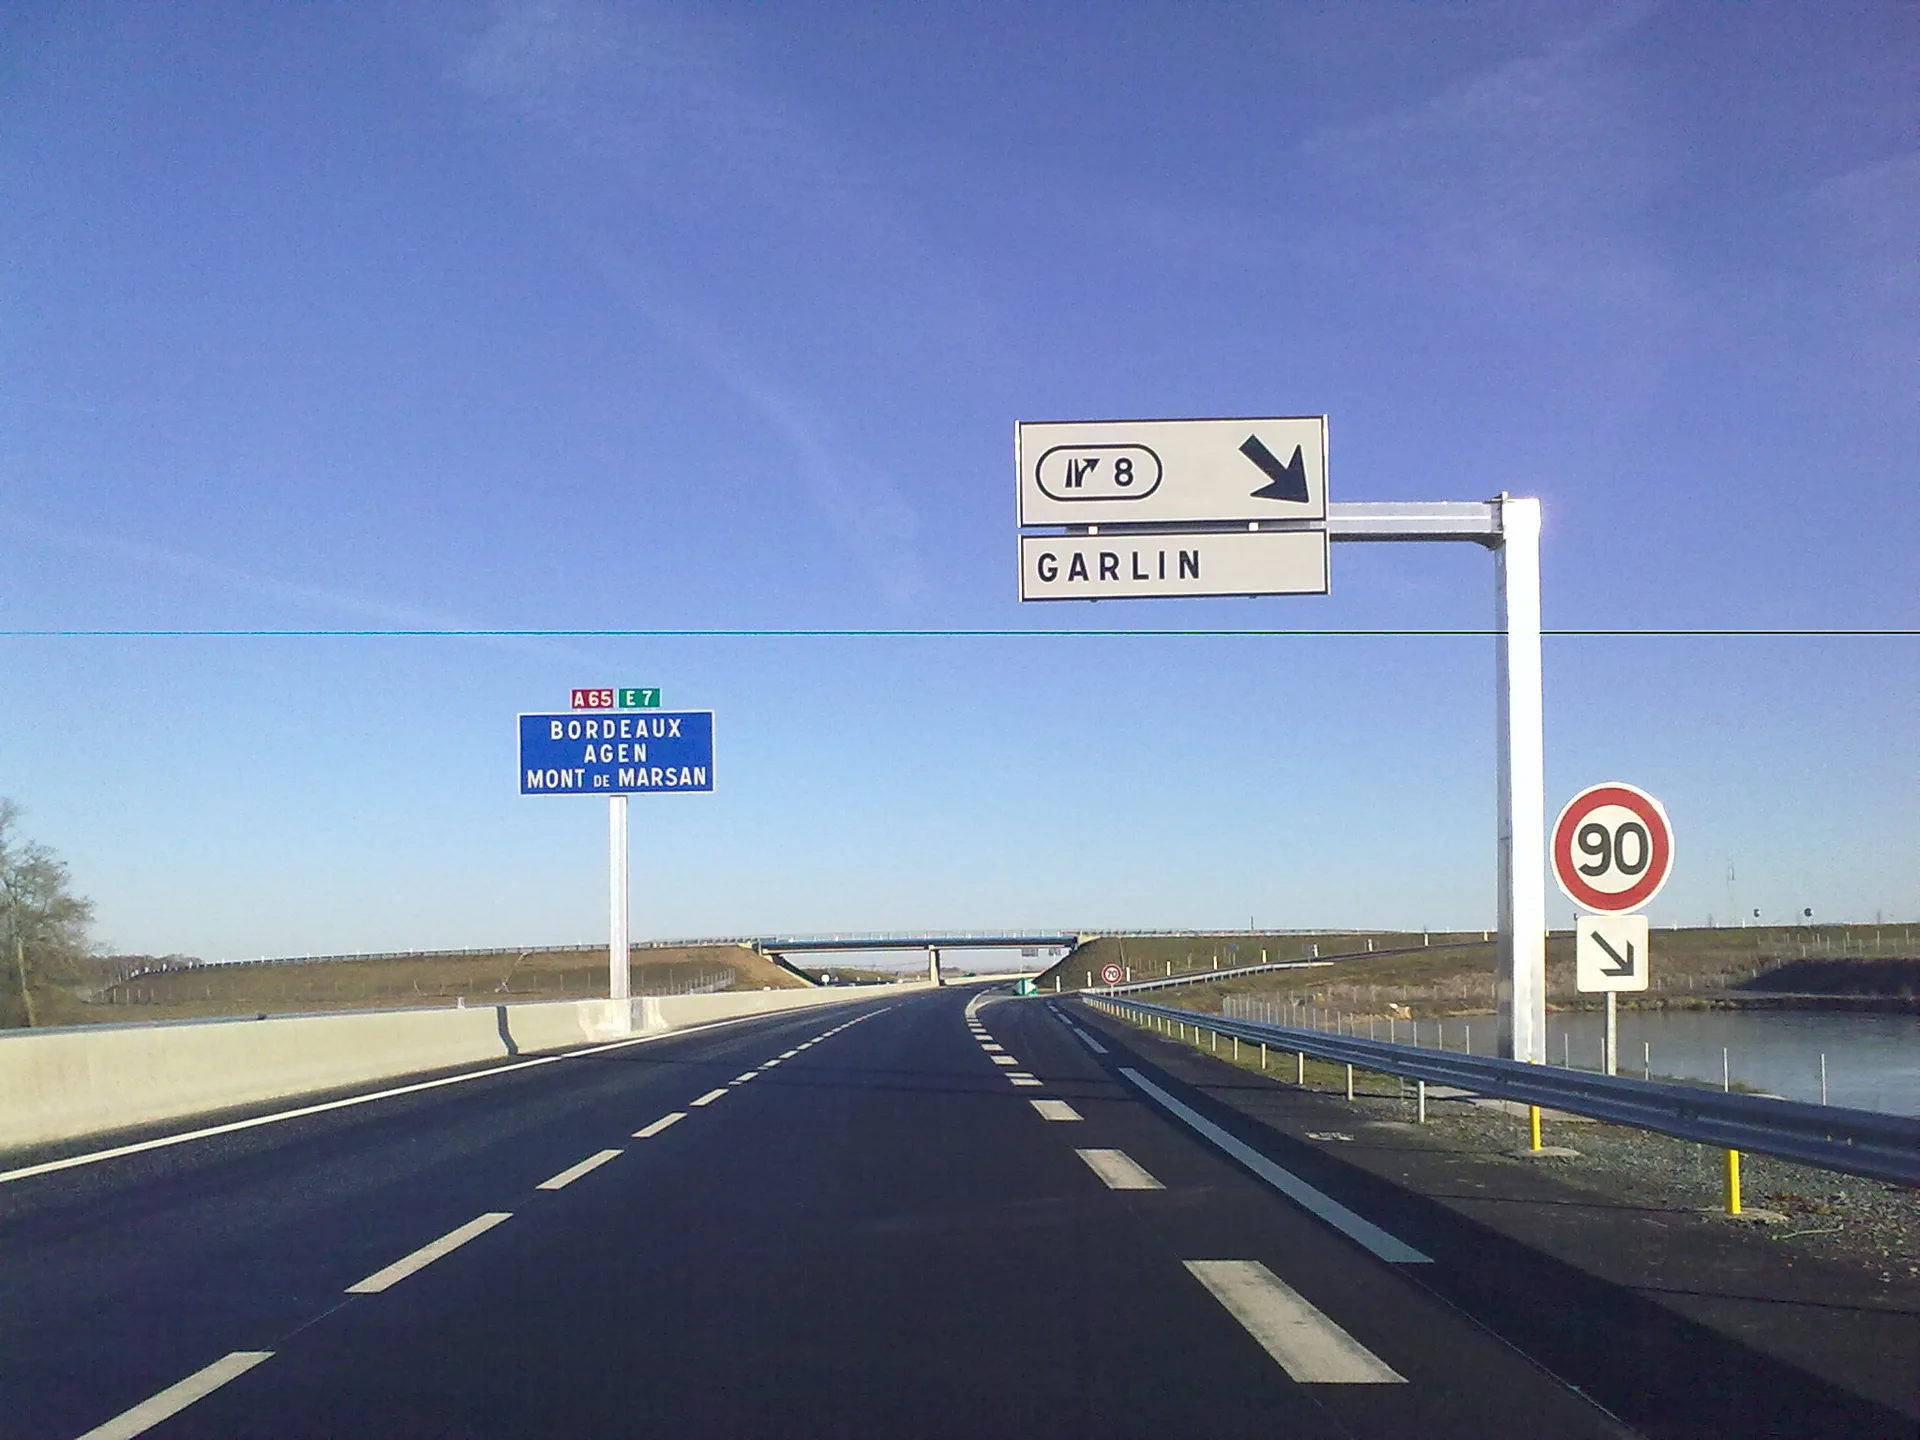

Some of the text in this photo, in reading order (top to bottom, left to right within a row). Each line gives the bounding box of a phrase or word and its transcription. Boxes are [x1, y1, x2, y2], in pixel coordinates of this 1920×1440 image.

[1114, 457, 1134, 487] 8
[1037, 550, 1200, 582] GARLIN
[551, 718, 681, 740] BORDEAUX
[584, 743, 647, 764] AGEN
[527, 766, 707, 789] MONT DE MARSAN
[1578, 821, 1649, 877] 90
[1107, 970, 1117, 978] 70
